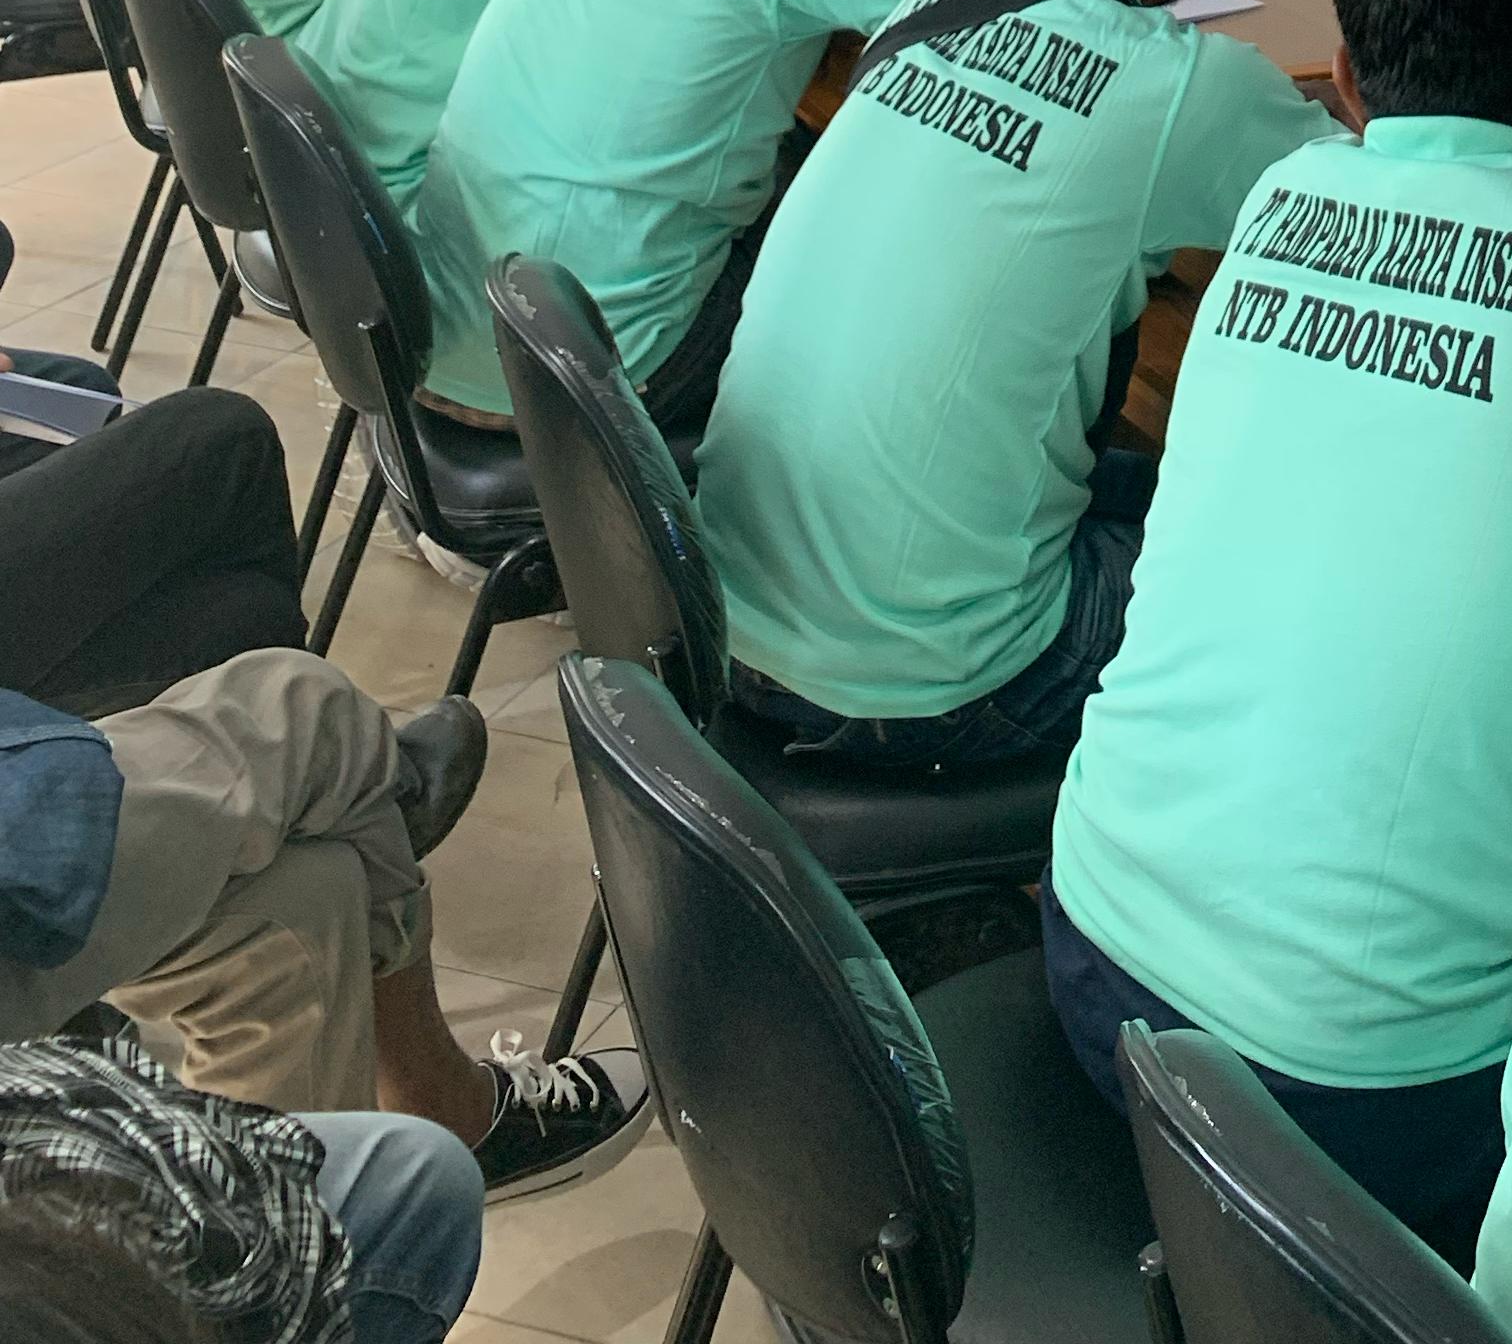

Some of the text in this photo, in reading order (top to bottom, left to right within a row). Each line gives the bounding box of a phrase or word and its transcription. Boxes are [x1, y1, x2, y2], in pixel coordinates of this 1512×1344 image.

[876, 62, 1044, 172] INDONESIA
[1019, 32, 1120, 118] INSANI
[1258, 191, 1389, 281] HAMPARAN
[1369, 210, 1464, 297] KARYA
[1214, 279, 1496, 403] NTB INDONESIA
